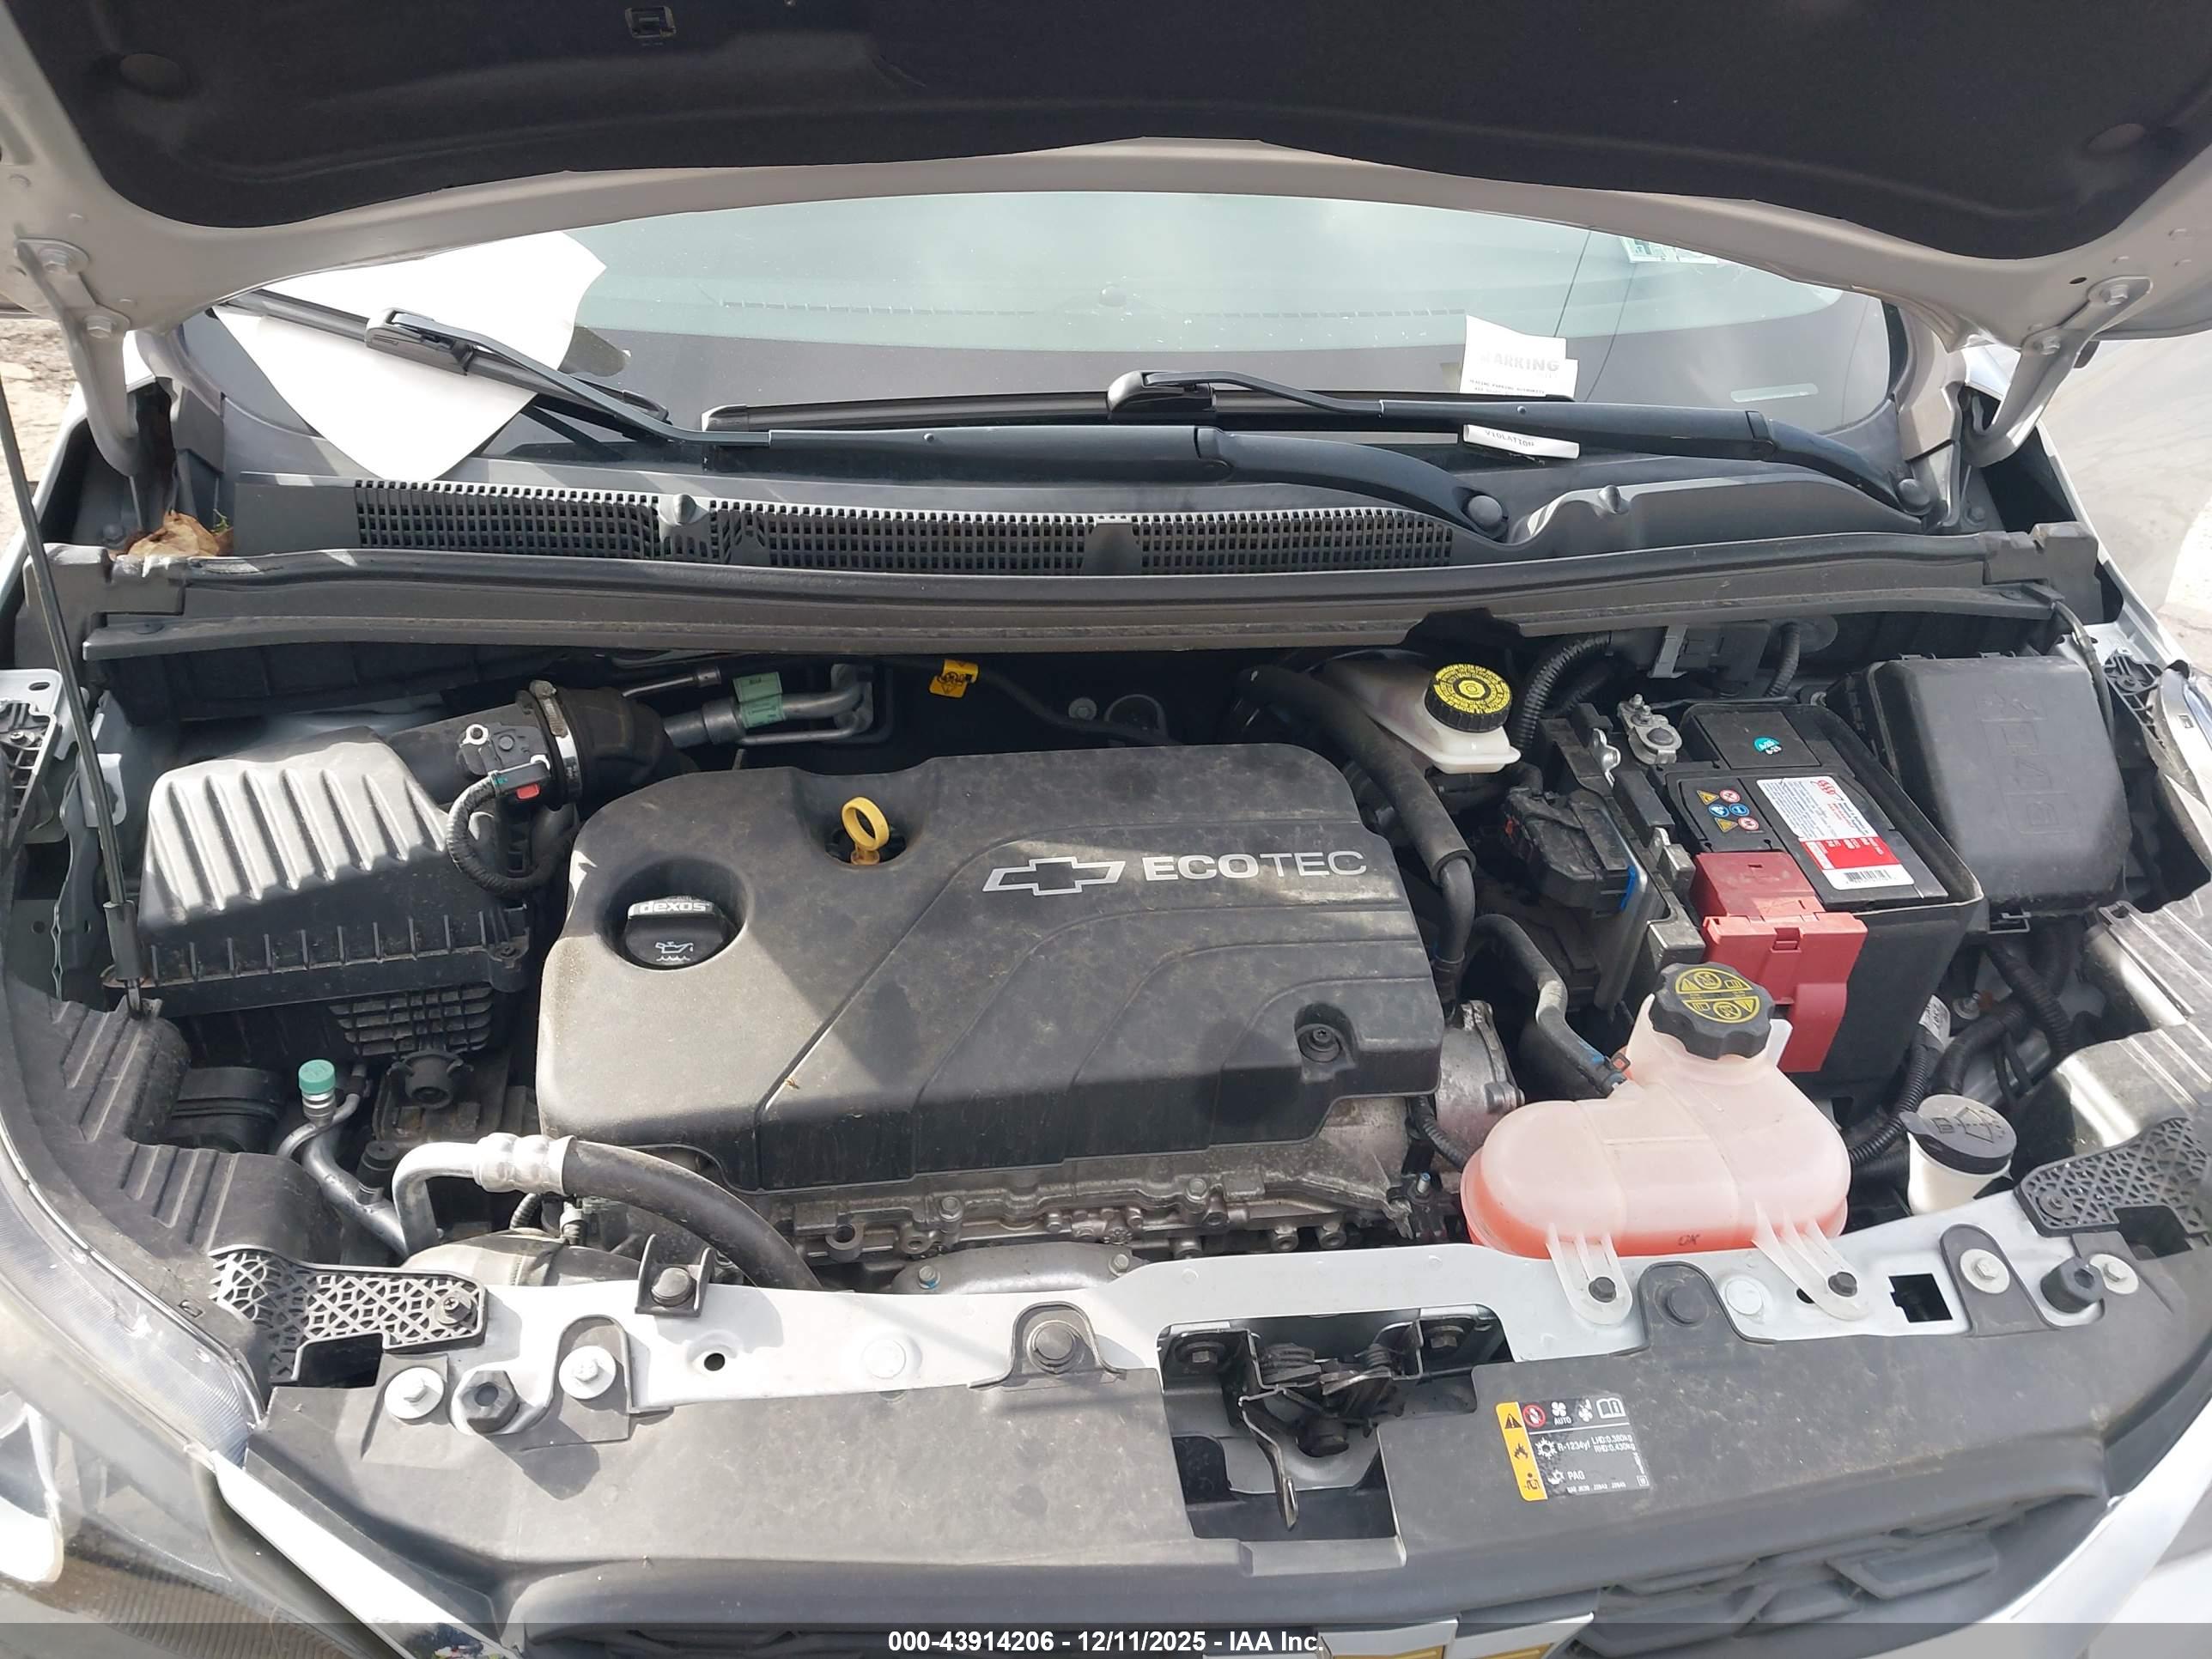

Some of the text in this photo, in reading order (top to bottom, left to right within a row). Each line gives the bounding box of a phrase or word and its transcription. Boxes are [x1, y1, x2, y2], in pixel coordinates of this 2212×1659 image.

[1484, 429, 1535, 447] VIOLATION
[1141, 850, 1367, 881] ECOTEC
[639, 901, 707, 914] dexos
[1553, 1416, 1572, 1425] AUTO
[1567, 1470, 1586, 1480] PAG
